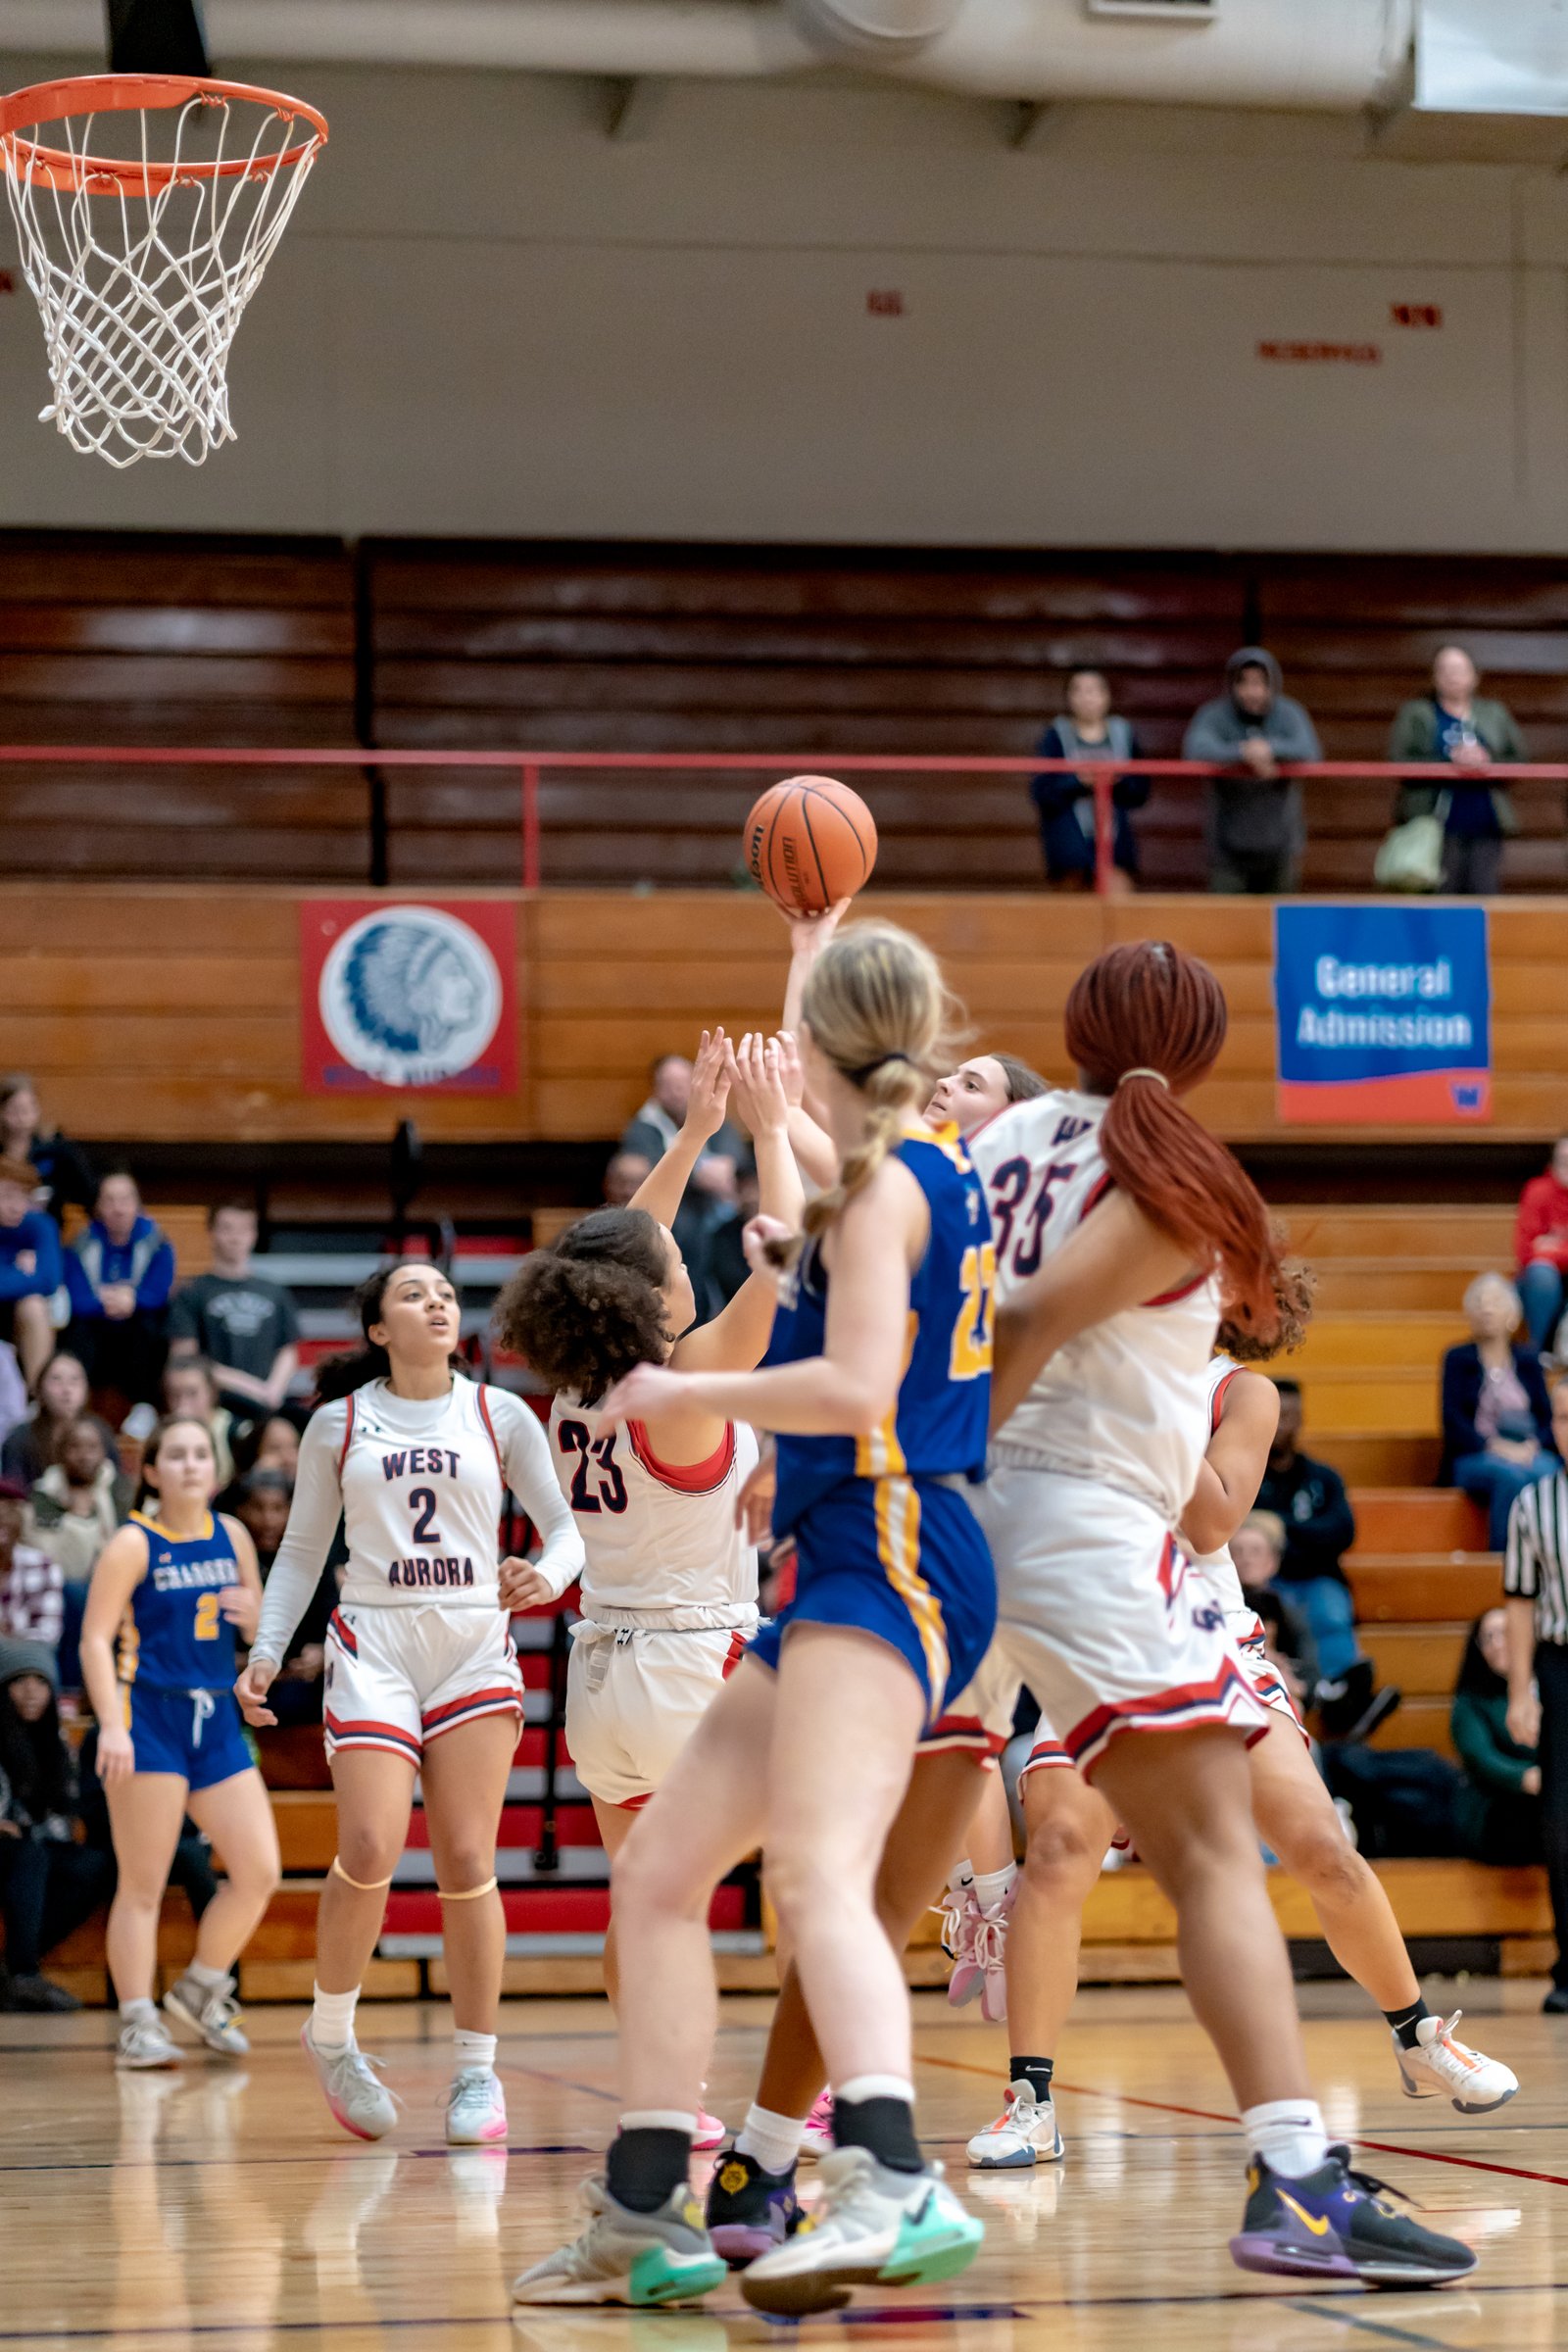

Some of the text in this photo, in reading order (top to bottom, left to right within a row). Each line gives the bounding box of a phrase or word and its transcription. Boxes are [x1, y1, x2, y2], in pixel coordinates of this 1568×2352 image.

[1315, 955, 1452, 1000] General
[1298, 1005, 1473, 1049] Admission
[990, 1153, 1078, 1277] 35
[381, 1448, 461, 1481] WEST
[558, 1418, 628, 1514] 23
[408, 1487, 441, 1544] 2
[388, 1556, 473, 1587] AURORA
[194, 1592, 220, 1641] 2
